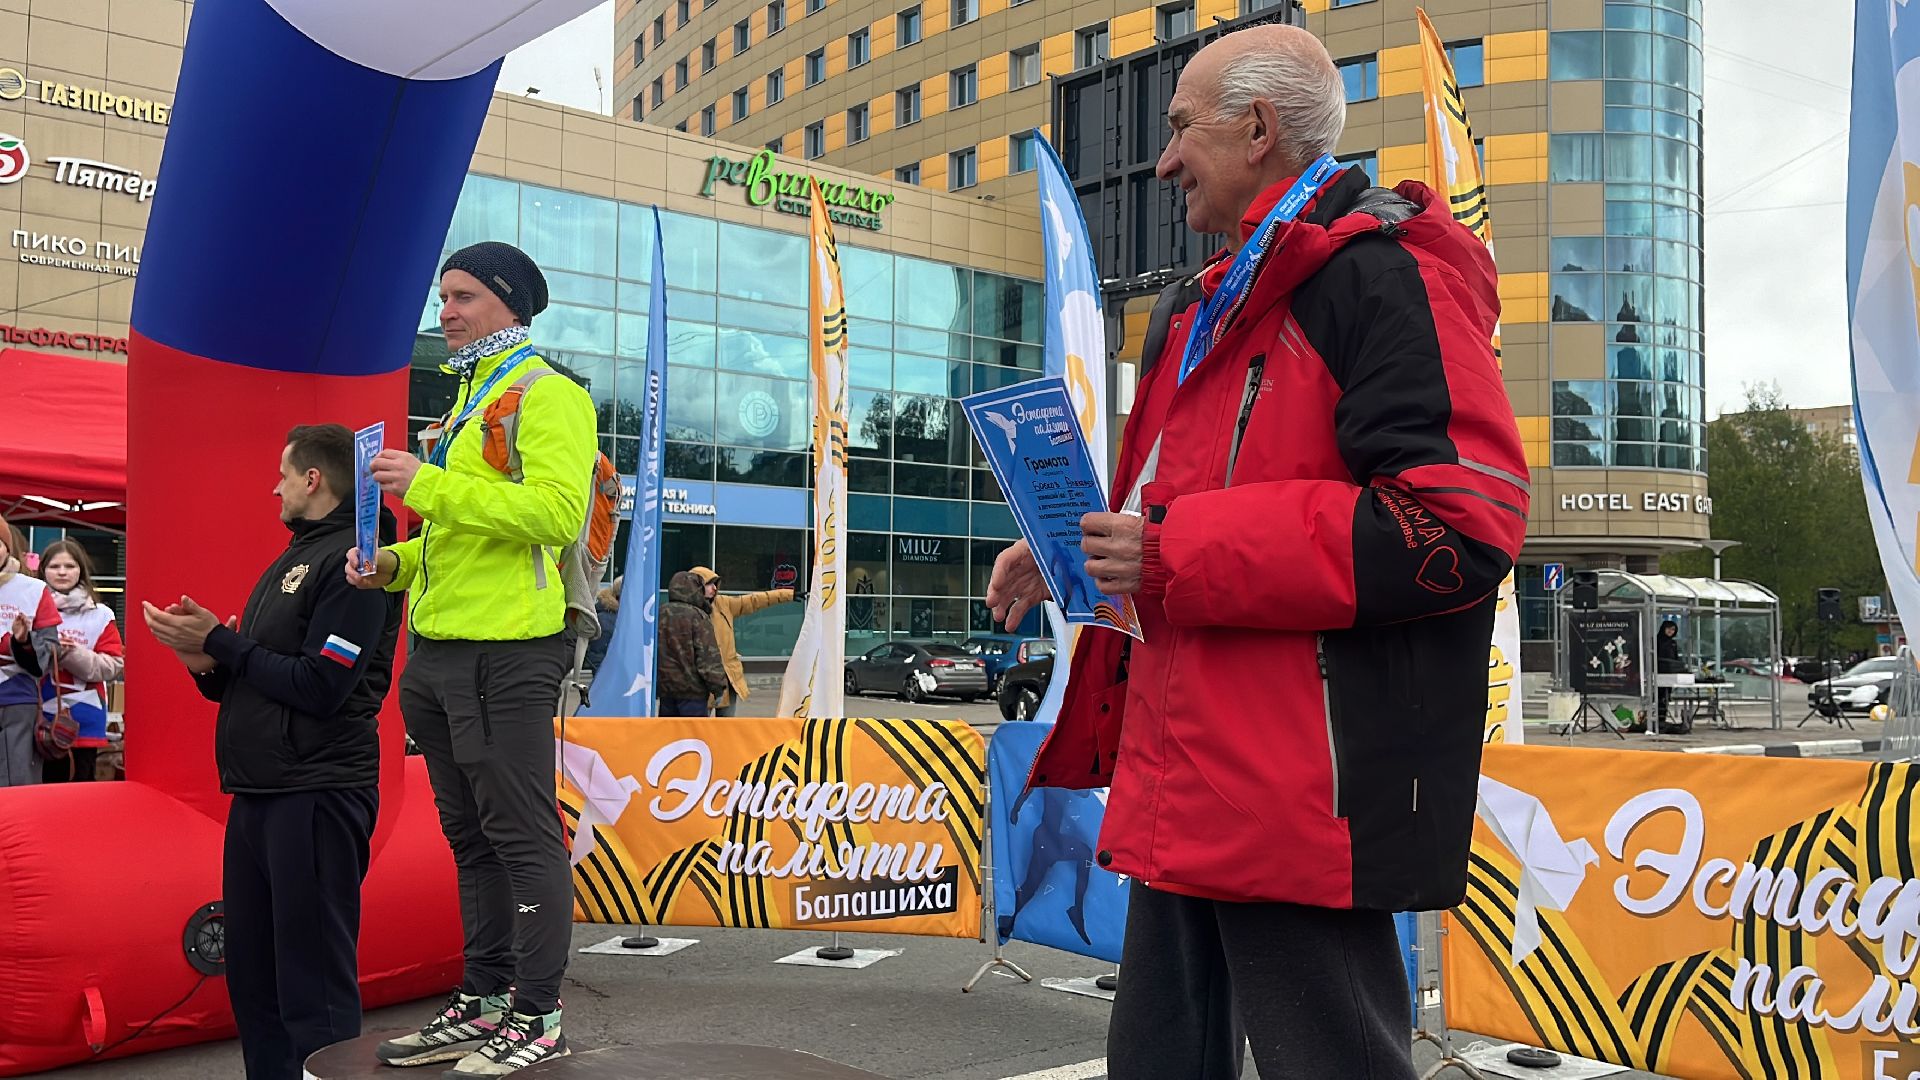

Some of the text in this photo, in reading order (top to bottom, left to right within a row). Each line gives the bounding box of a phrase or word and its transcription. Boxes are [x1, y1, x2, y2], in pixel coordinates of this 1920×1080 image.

[40, 79, 169, 125] ГАЗПРОМБ
[47, 156, 157, 202] Пятёр
[778, 199, 811, 216] СП
[12, 229, 87, 256] ПИКО
[20, 252, 110, 273] СОВРЕМЕННАЯ
[1023, 455, 1070, 475] Грамота
[669, 501, 717, 515] ТЕХНИКА
[1561, 493, 1634, 511] HOTEL
[1643, 492, 1690, 512] EAST
[899, 537, 942, 556] MIUZ
[645, 738, 950, 841] Эстафета
[716, 837, 947, 884] памяти
[795, 882, 952, 922] Балашиха
